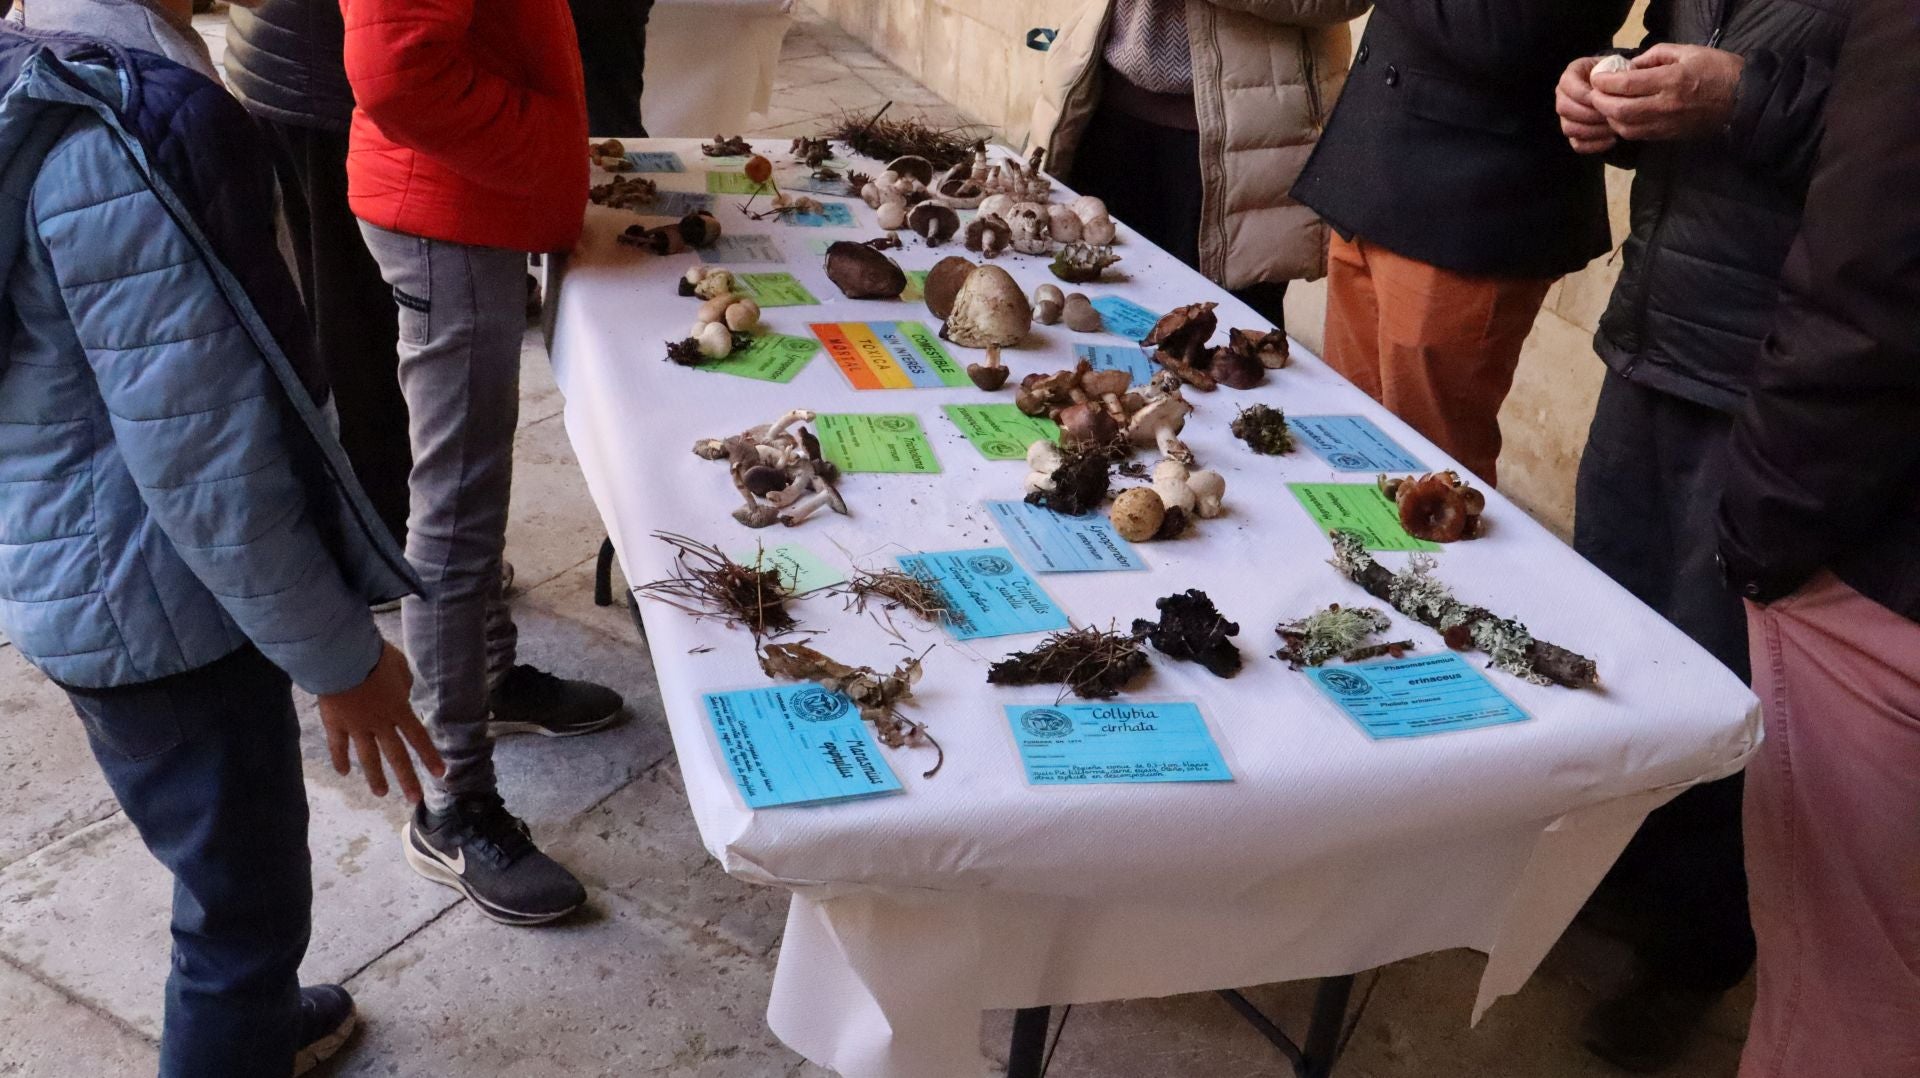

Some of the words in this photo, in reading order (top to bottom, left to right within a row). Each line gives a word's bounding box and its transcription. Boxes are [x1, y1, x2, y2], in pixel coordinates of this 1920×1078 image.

[829, 338, 861, 372] MORTAL
[883, 334, 900, 344] SIN
[912, 334, 955, 373] COMESTIBLE
[904, 437, 925, 470] Tricholoma
[1091, 525, 1131, 567] Lycoperdon
[1408, 673, 1462, 685] erinaceus
[1092, 708, 1158, 721] Collybia
[1102, 722, 1156, 731] cirrhata
[819, 742, 853, 778] epiphyllus
[846, 740, 883, 784] Marasmius
